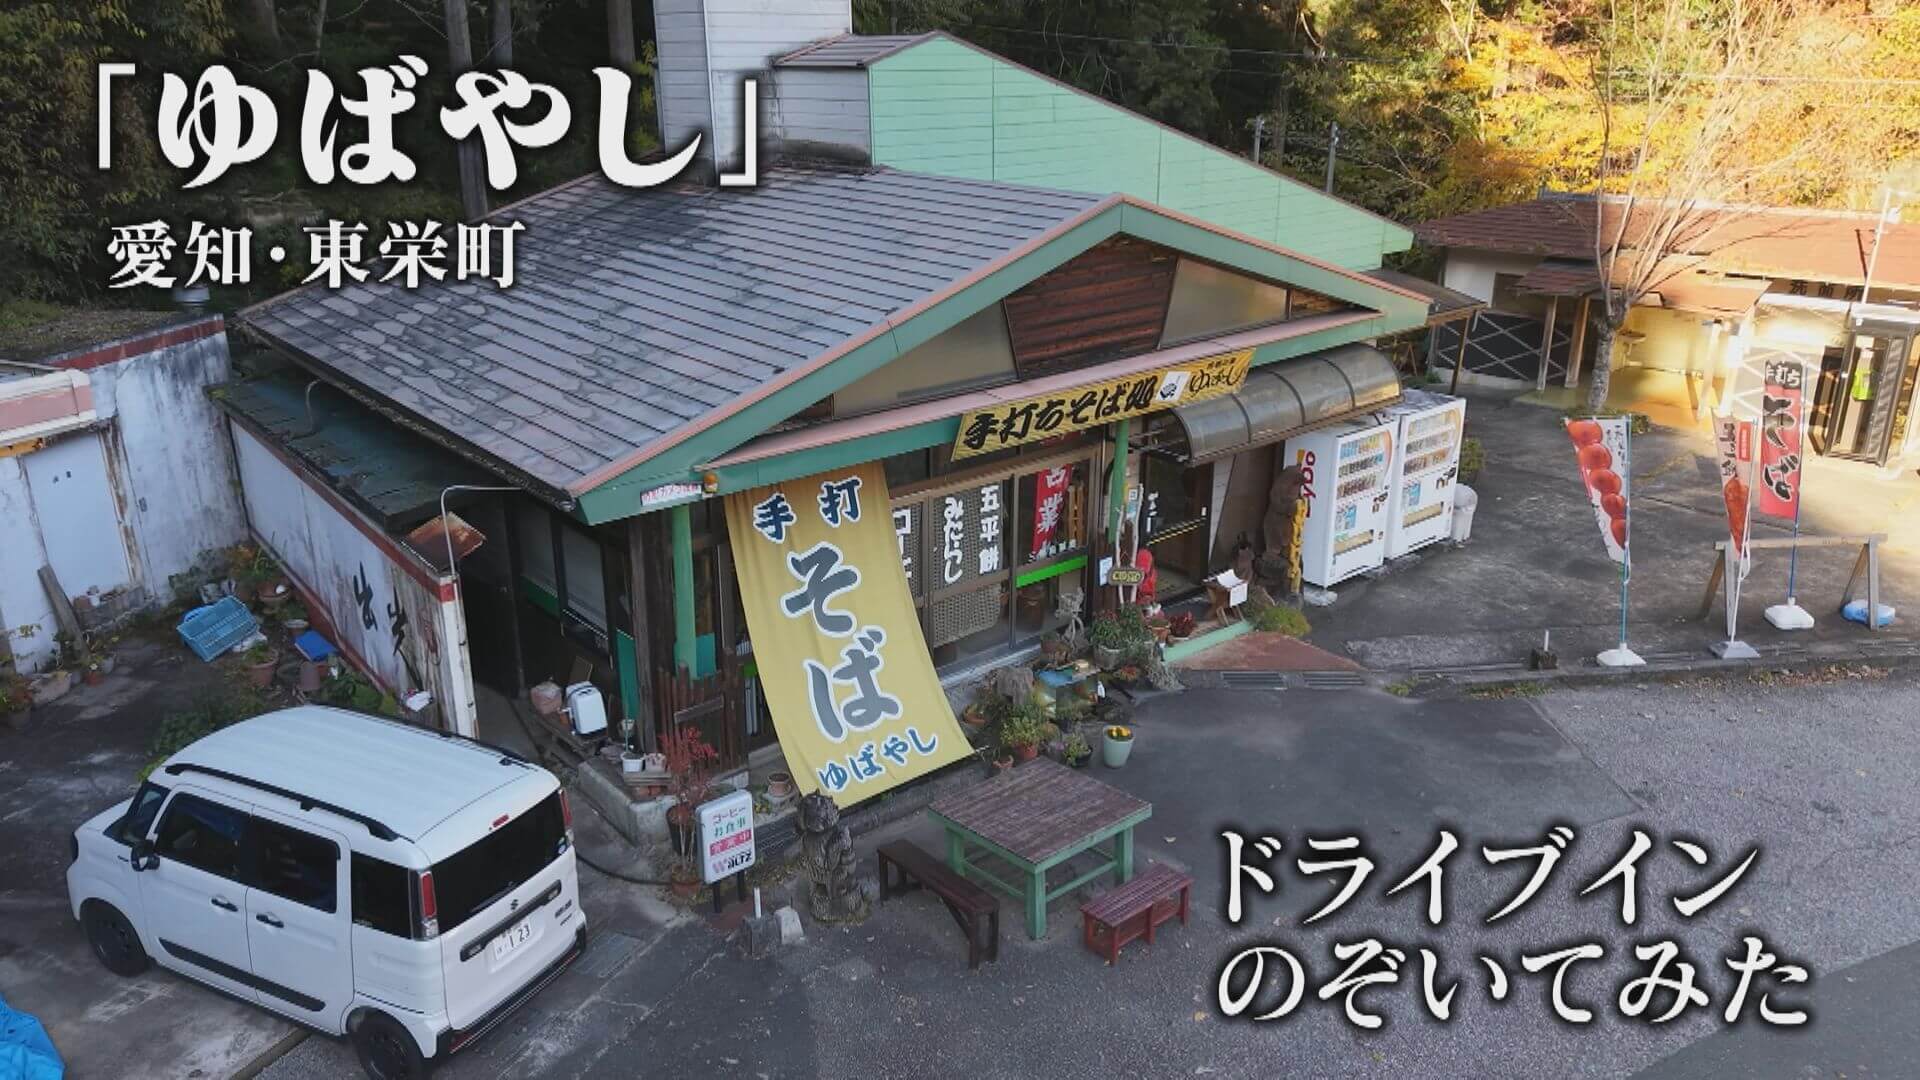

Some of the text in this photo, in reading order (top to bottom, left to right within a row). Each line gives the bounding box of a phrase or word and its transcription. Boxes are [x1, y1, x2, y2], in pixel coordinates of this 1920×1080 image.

[962, 375, 1158, 449] 手打ちそば処
[755, 477, 862, 543] 手打
[1301, 451, 1316, 518] yDo
[944, 497, 963, 584] みたらし
[979, 485, 999, 575] 五平餅
[780, 541, 902, 742] そば
[820, 727, 937, 792] ゆばやし
[713, 807, 746, 825] コーヒー
